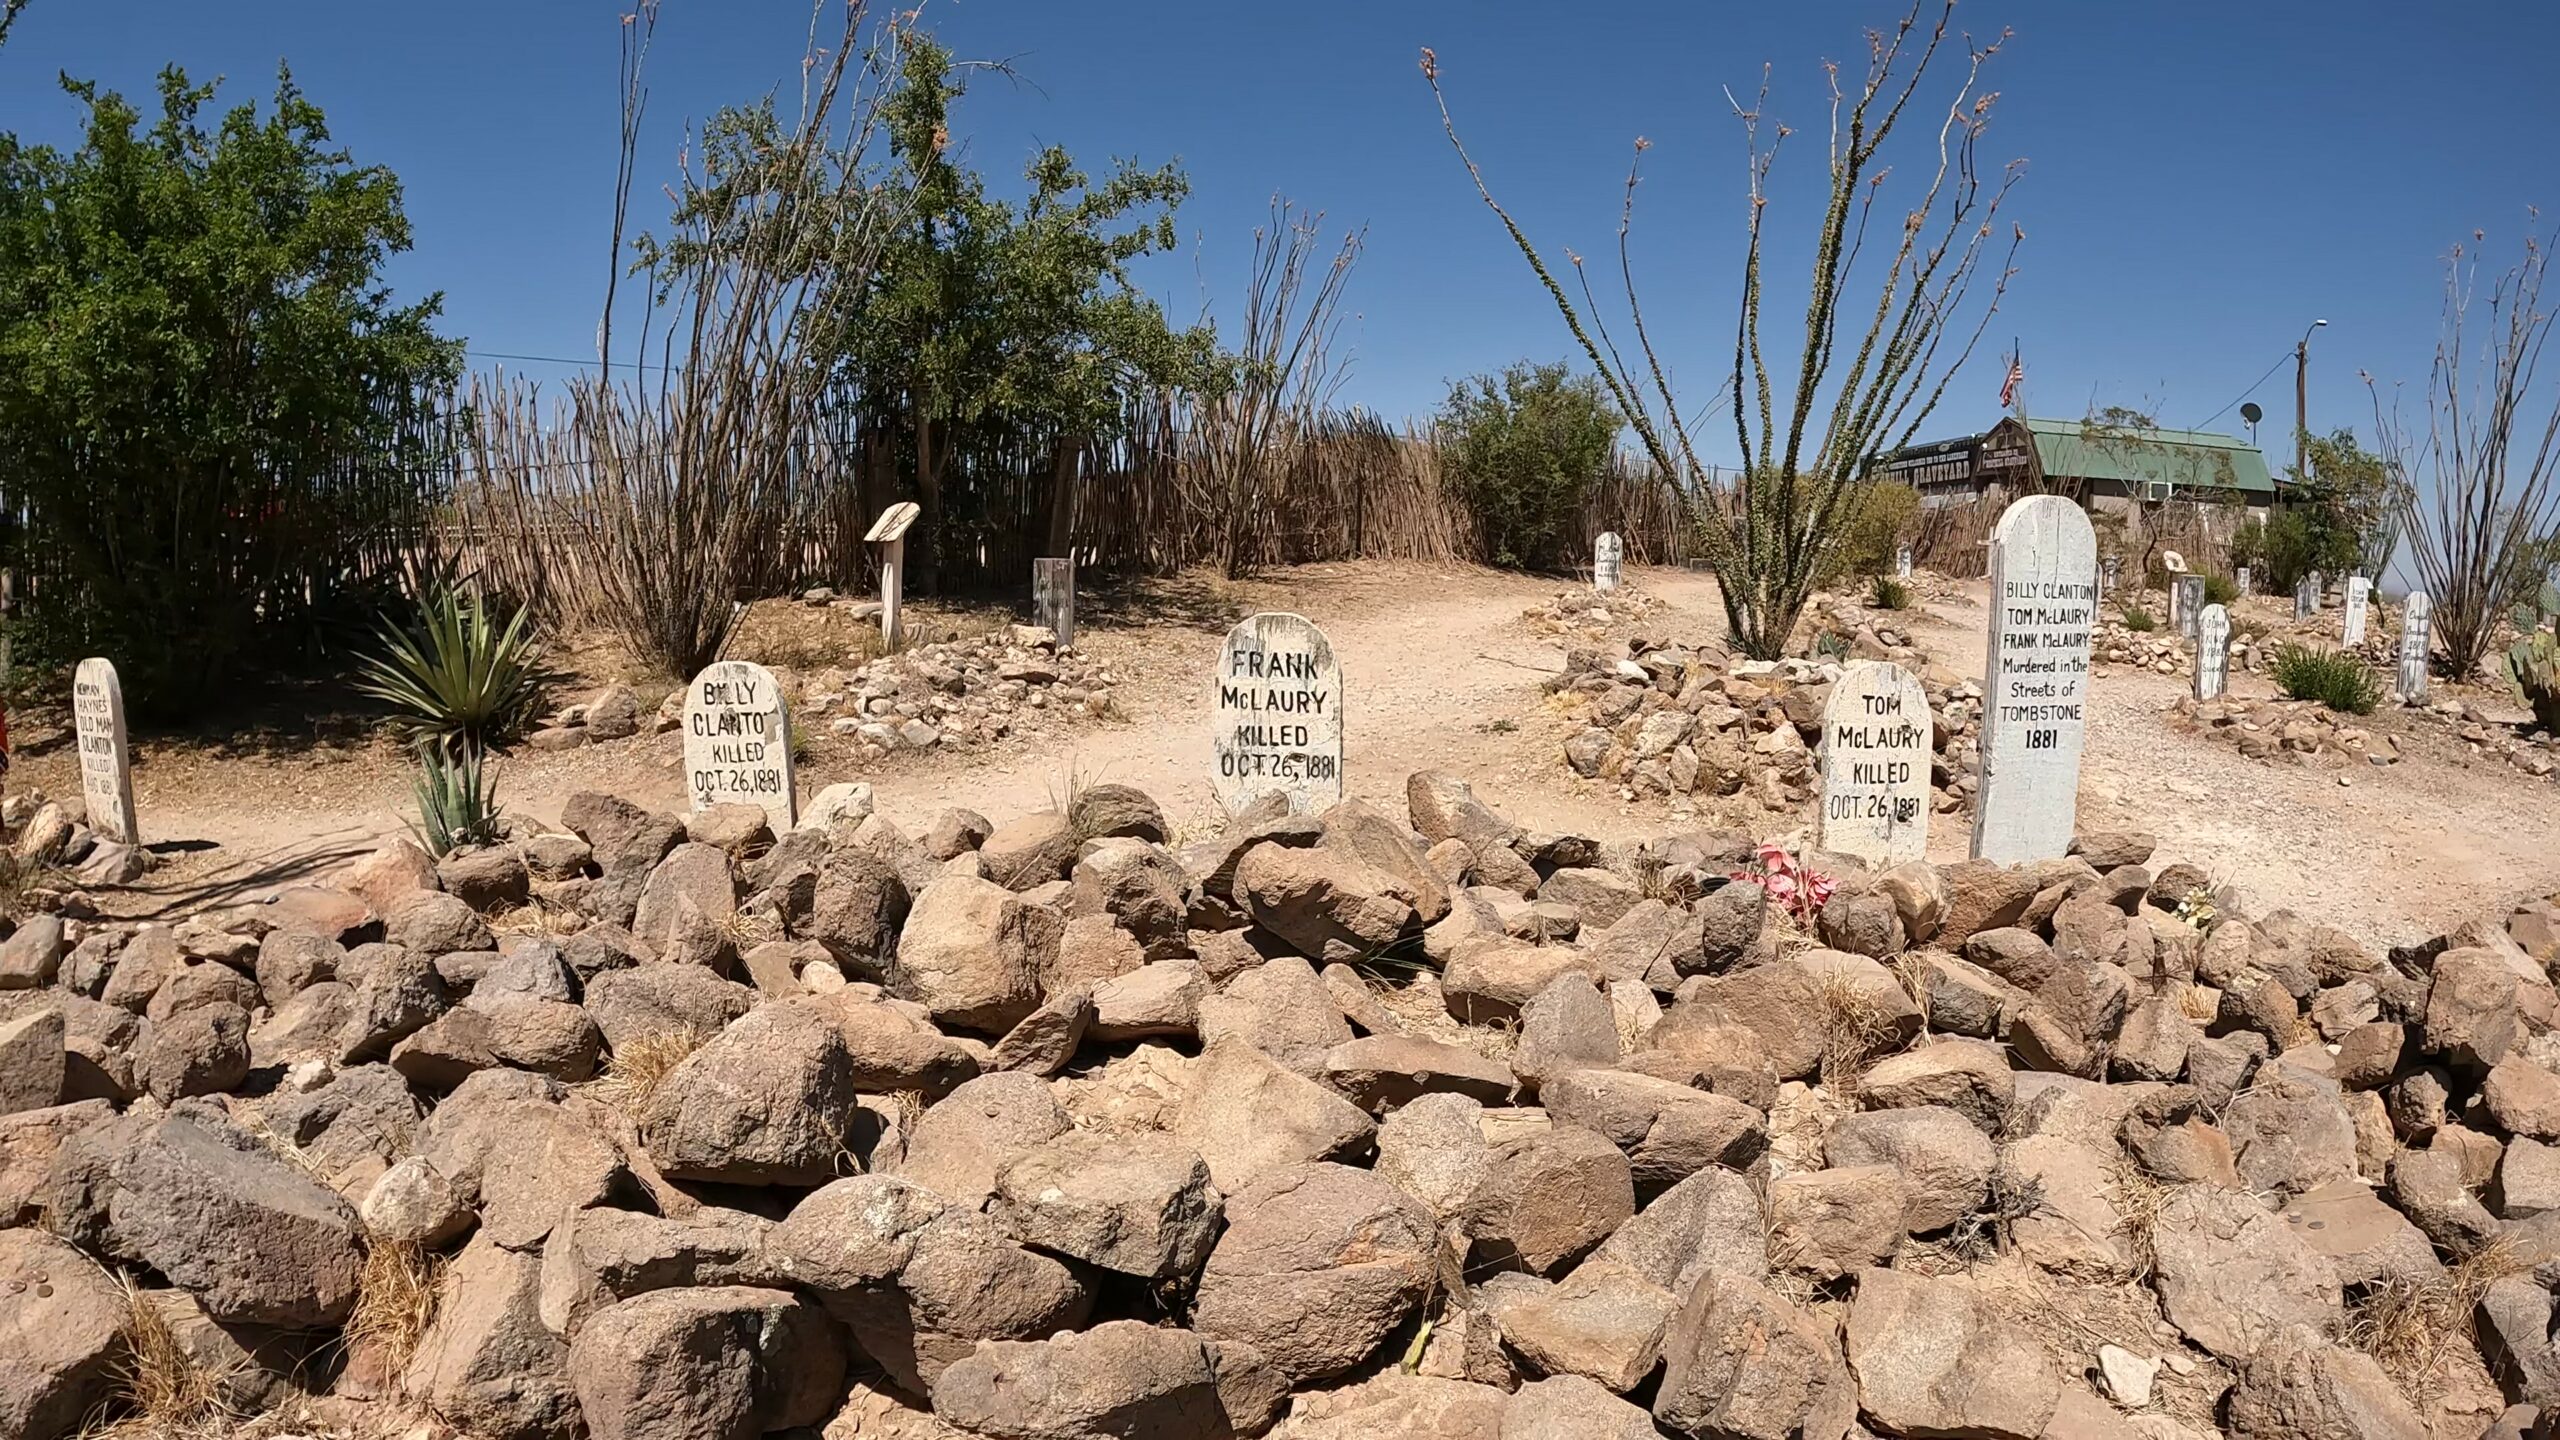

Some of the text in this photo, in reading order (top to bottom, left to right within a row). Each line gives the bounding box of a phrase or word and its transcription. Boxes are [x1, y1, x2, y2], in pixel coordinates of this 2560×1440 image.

[1913, 460, 1970, 489] GRAVEYARD
[2006, 582, 2093, 600] BILLY CLANTON
[2008, 608, 2090, 625] TOM McLAURY
[2003, 633, 2089, 649] FRANK McLAURY
[1232, 650, 1318, 679] FRANK
[2003, 656, 2088, 674] Murdered in the
[2011, 680, 2076, 698] Streets of
[1221, 685, 1327, 714] McLAURY
[1862, 695, 1900, 715] TOM
[2000, 704, 2082, 722] TOMBSTONE
[693, 711, 769, 736] CLANTO
[1237, 725, 1308, 747] KILLED
[1837, 725, 1924, 749] McLAURY
[2026, 729, 2058, 749] 1881
[712, 743, 764, 763] KILLED
[1853, 762, 1910, 784] KILLED
